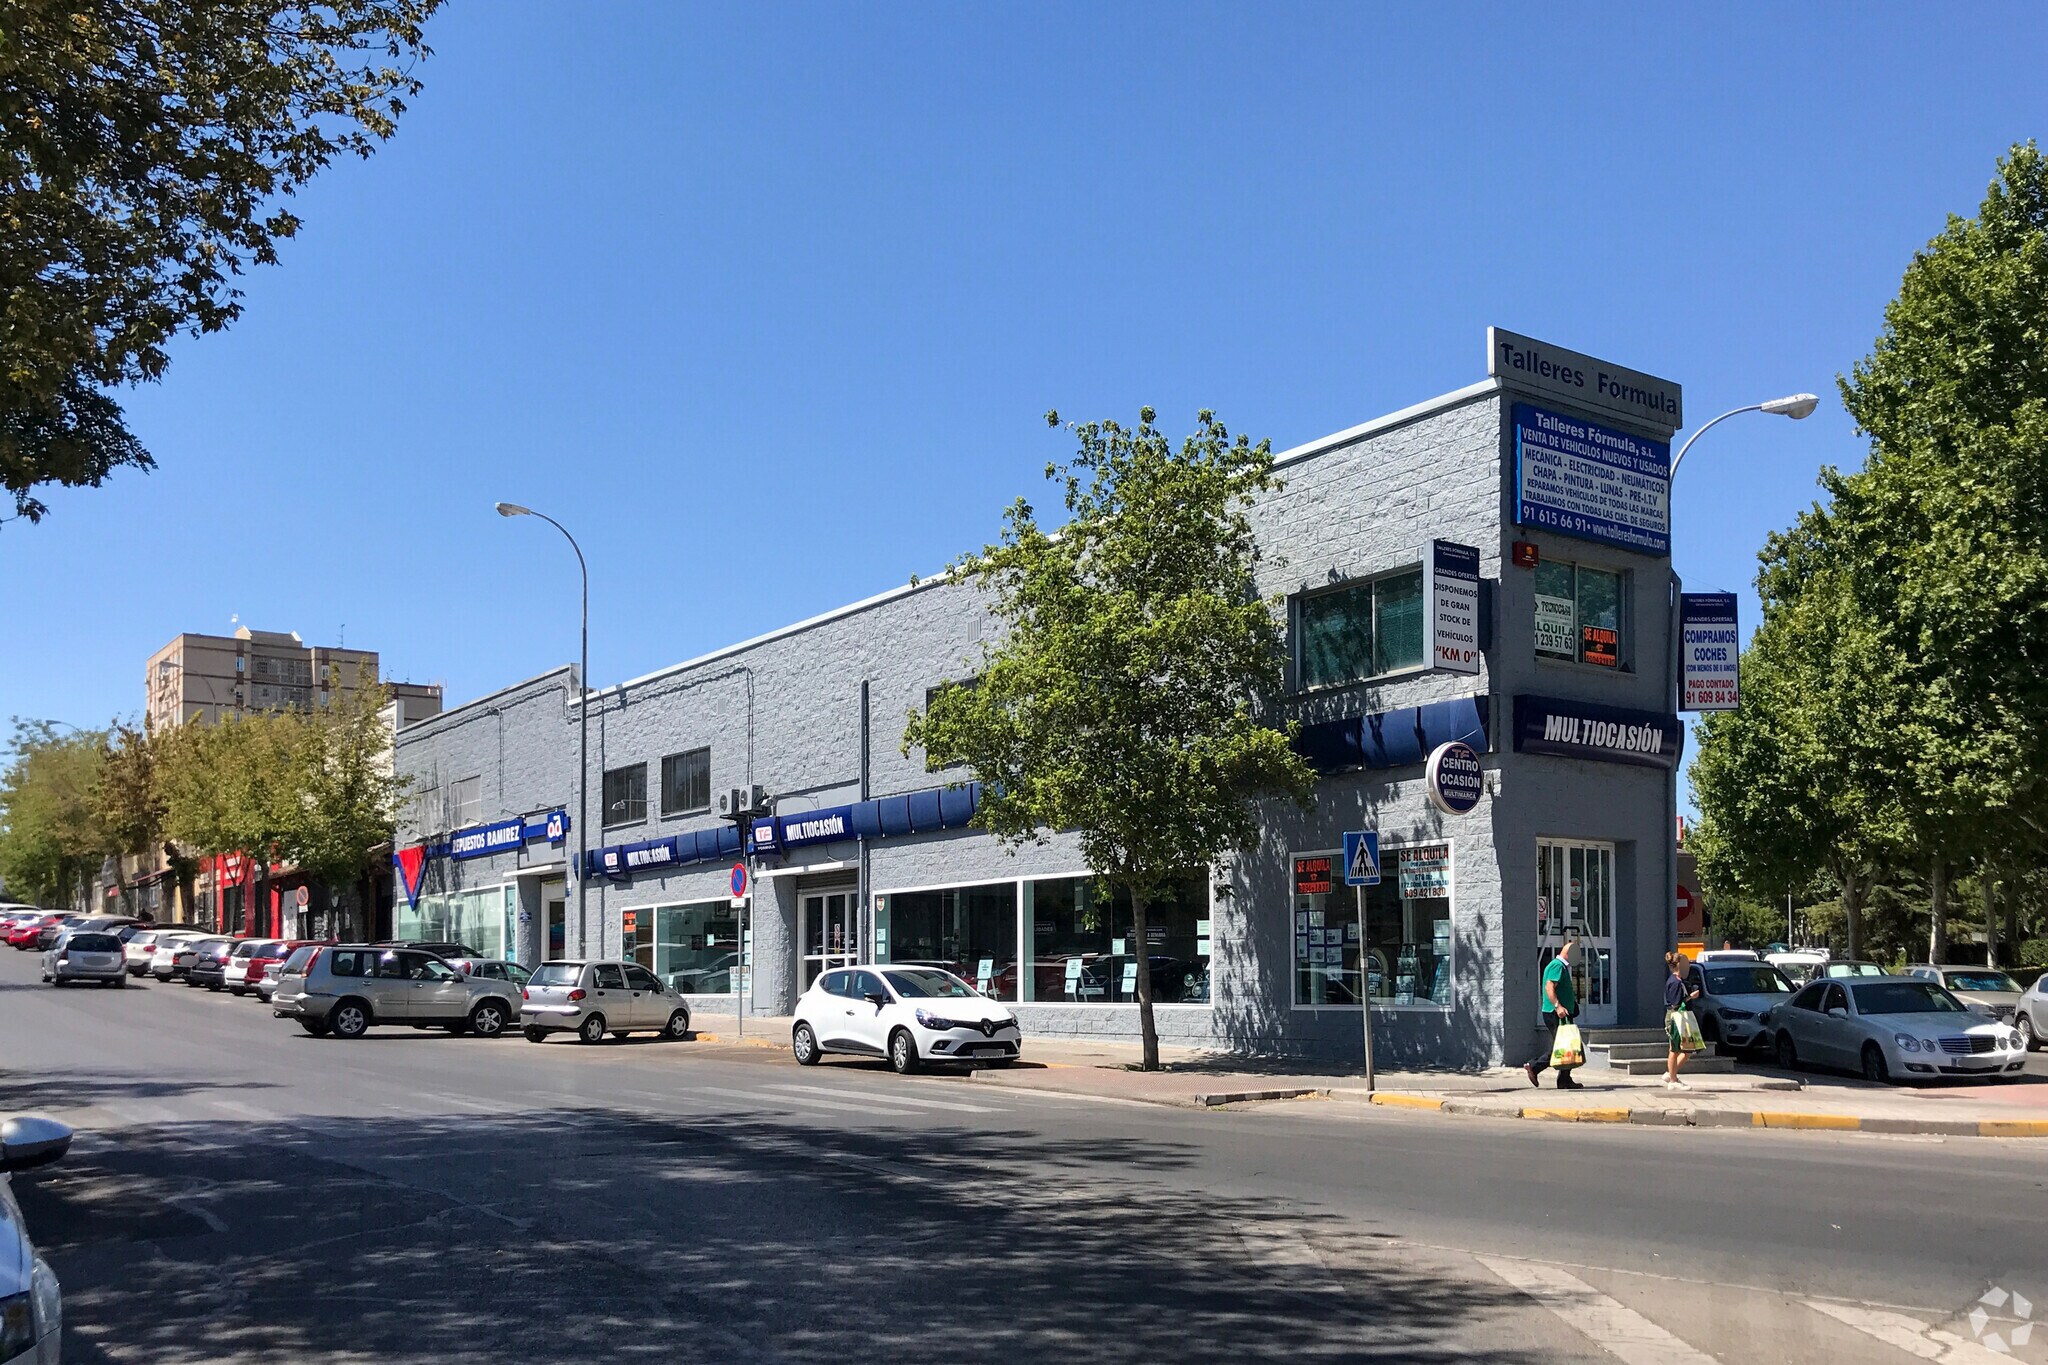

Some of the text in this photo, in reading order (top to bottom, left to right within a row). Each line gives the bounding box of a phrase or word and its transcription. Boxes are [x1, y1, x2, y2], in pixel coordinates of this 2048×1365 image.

[1501, 342, 1677, 415] Talleres Fórmula
[1536, 413, 1585, 439] Talleres
[1588, 428, 1639, 456] Fórmula,
[1523, 427, 1547, 446] VENTA
[1549, 434, 1559, 447] DE
[1602, 449, 1631, 469] NUEVOS
[1633, 458, 1638, 468] Y
[1639, 460, 1667, 477] USADOS
[1525, 447, 1664, 494] MECÁNICA ELECTRICIDAD NEUMÁTICOS
[1533, 465, 1557, 481] CHAPA
[1563, 473, 1594, 490] PINTURA
[1600, 482, 1623, 498] LUNAS
[1527, 478, 1564, 495] REPARAMOS
[1599, 496, 1607, 505] DE
[1609, 498, 1628, 510] TODAS
[1629, 504, 1639, 513] LAS
[1641, 507, 1663, 519] MARCAS
[1525, 490, 1565, 508] TRABAJAMOS
[1567, 499, 1580, 511] CON
[1582, 504, 1601, 516] TODAS
[1603, 509, 1613, 519] LAS
[1630, 516, 1638, 525] DE
[1639, 518, 1665, 531] SEGUROS
[1523, 506, 1534, 520] 91
[1539, 510, 1557, 525] 615
[1560, 515, 1573, 528] 66
[1592, 523, 1665, 549] www.talleresformula.com
[1435, 567, 1477, 580] GRANDES OFERTAS
[1435, 583, 1477, 598] DISPONEMOS
[1441, 599, 1470, 611] DE GRAN
[1440, 613, 1470, 626] STOCK DE
[1437, 629, 1473, 643] VEHÍCULOS
[1535, 622, 1574, 636] LQUILA
[1585, 627, 1616, 644] SE ALQUILA
[1685, 629, 1736, 644] COMPRAMOS
[1541, 634, 1553, 646] 239
[1555, 636, 1562, 648] 57
[1565, 637, 1572, 649] 63
[1694, 647, 1727, 661] COCHES
[1697, 664, 1712, 672] MENOS
[1713, 664, 1719, 672] DE
[1688, 679, 1734, 689] PAGO CONTADO
[1686, 691, 1737, 703] 91 609 84 34
[1544, 714, 1663, 754] MULTIOCASIÓN
[1442, 757, 1478, 772] CENTRO
[1440, 773, 1480, 788] OCASIÓN
[1444, 789, 1476, 799] MULTIMARCA
[786, 814, 844, 842] MULTIOCASIÓN
[487, 825, 520, 847] RAMIREZ
[627, 844, 671, 867] MULTIOCASIÓN
[1401, 847, 1448, 862] SE ALQUILA
[1297, 859, 1330, 873] SE ALQUILA
[1404, 886, 1446, 898] 609 421 830
